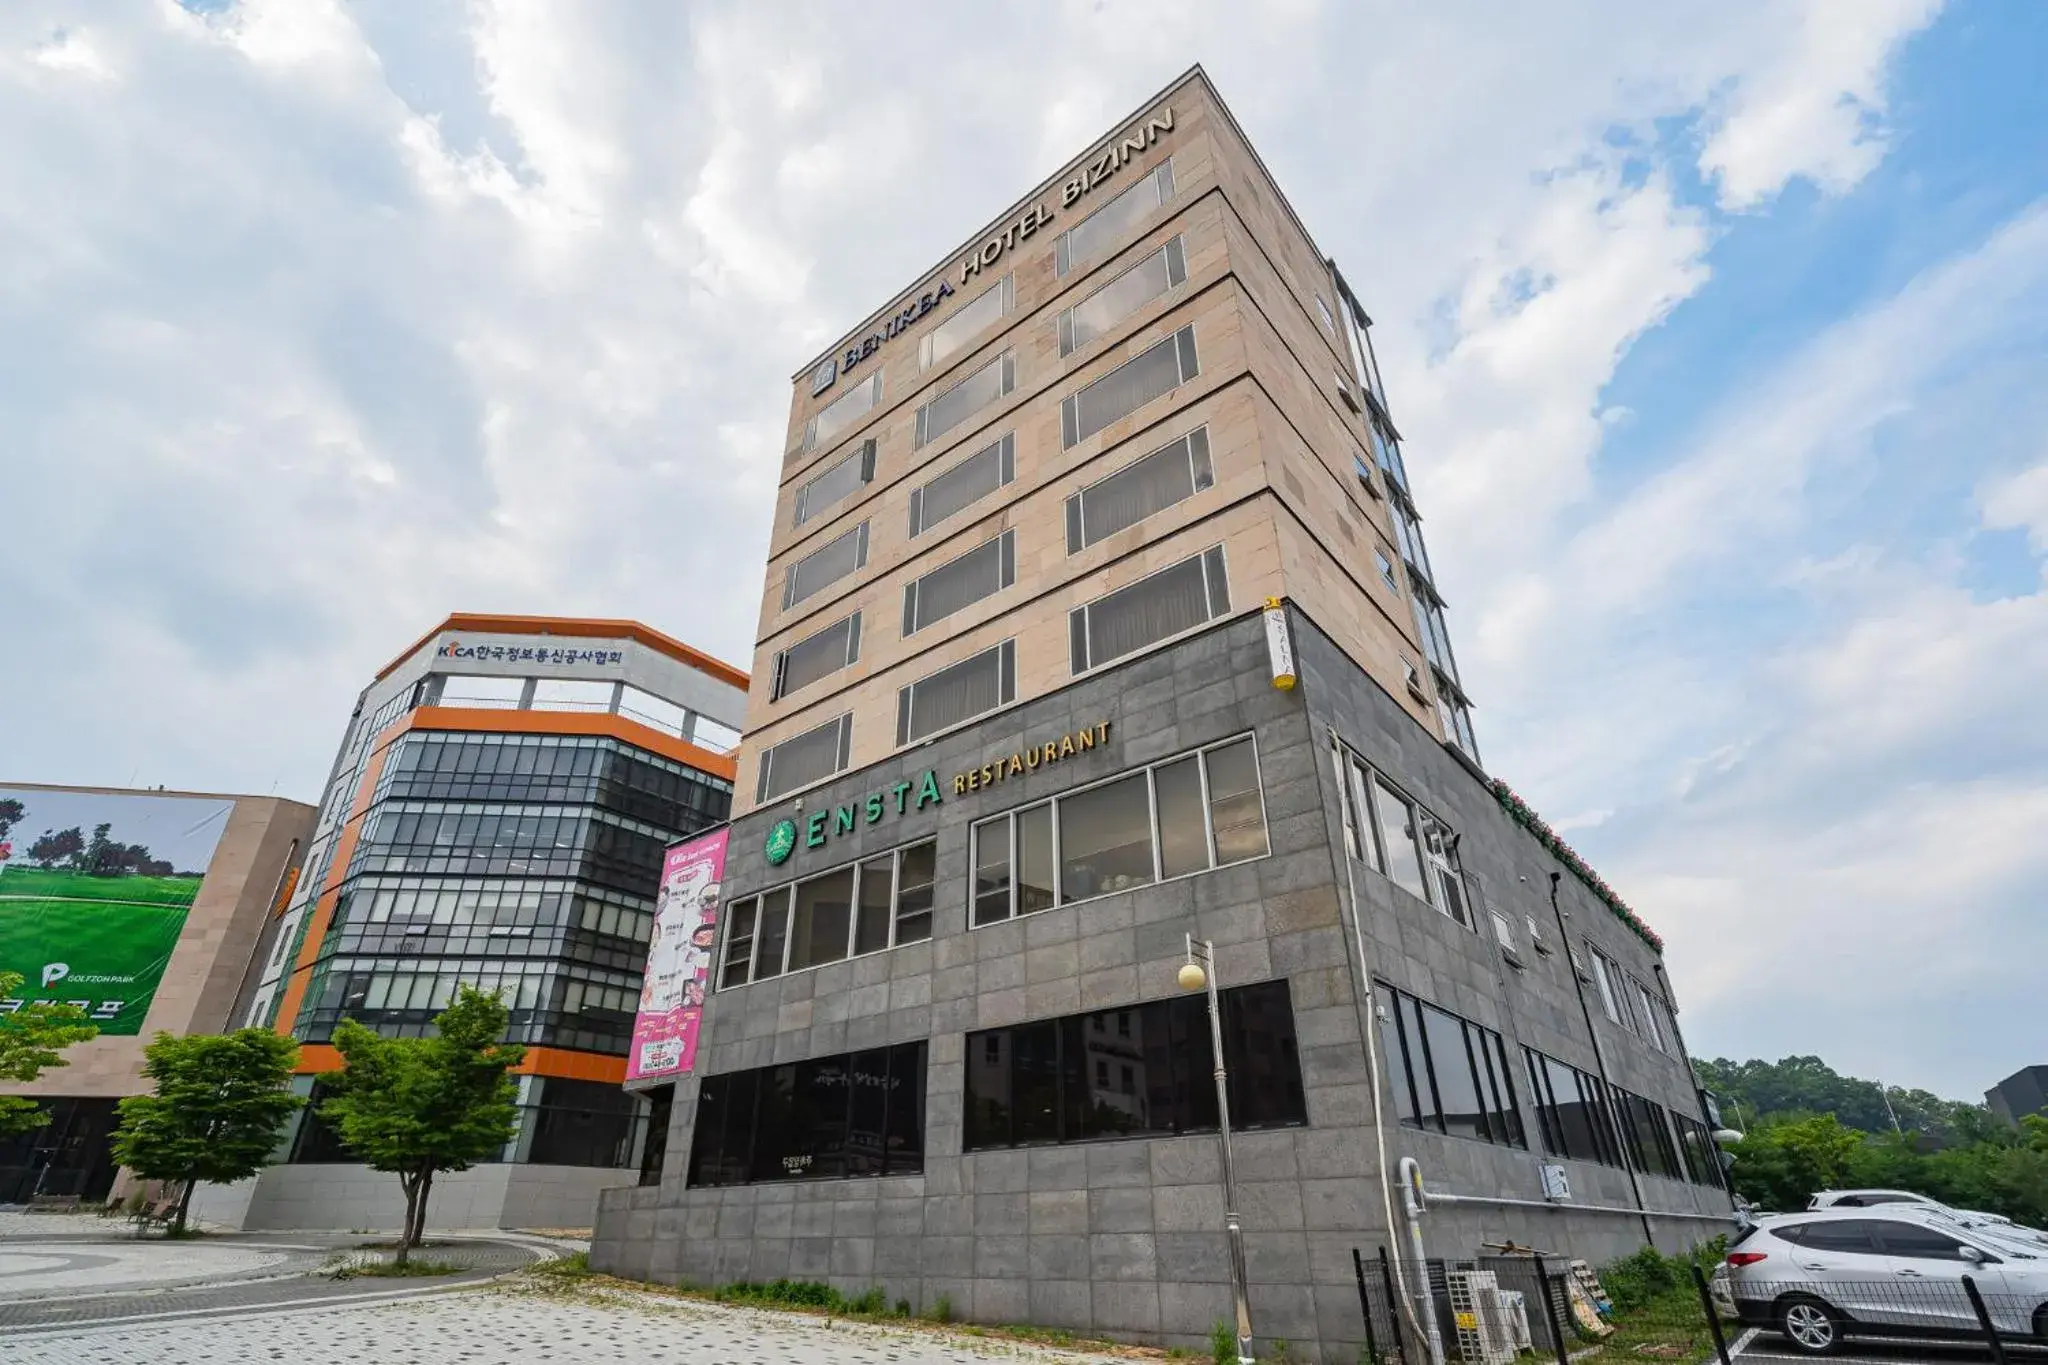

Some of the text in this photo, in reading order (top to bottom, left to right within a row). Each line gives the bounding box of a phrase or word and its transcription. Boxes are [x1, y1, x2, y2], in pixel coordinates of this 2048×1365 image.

[842, 106, 1176, 375] BENIKEA HOTEL BIZINN
[806, 769, 943, 849] ENSTA
[953, 720, 1112, 796] RESTAURANT
